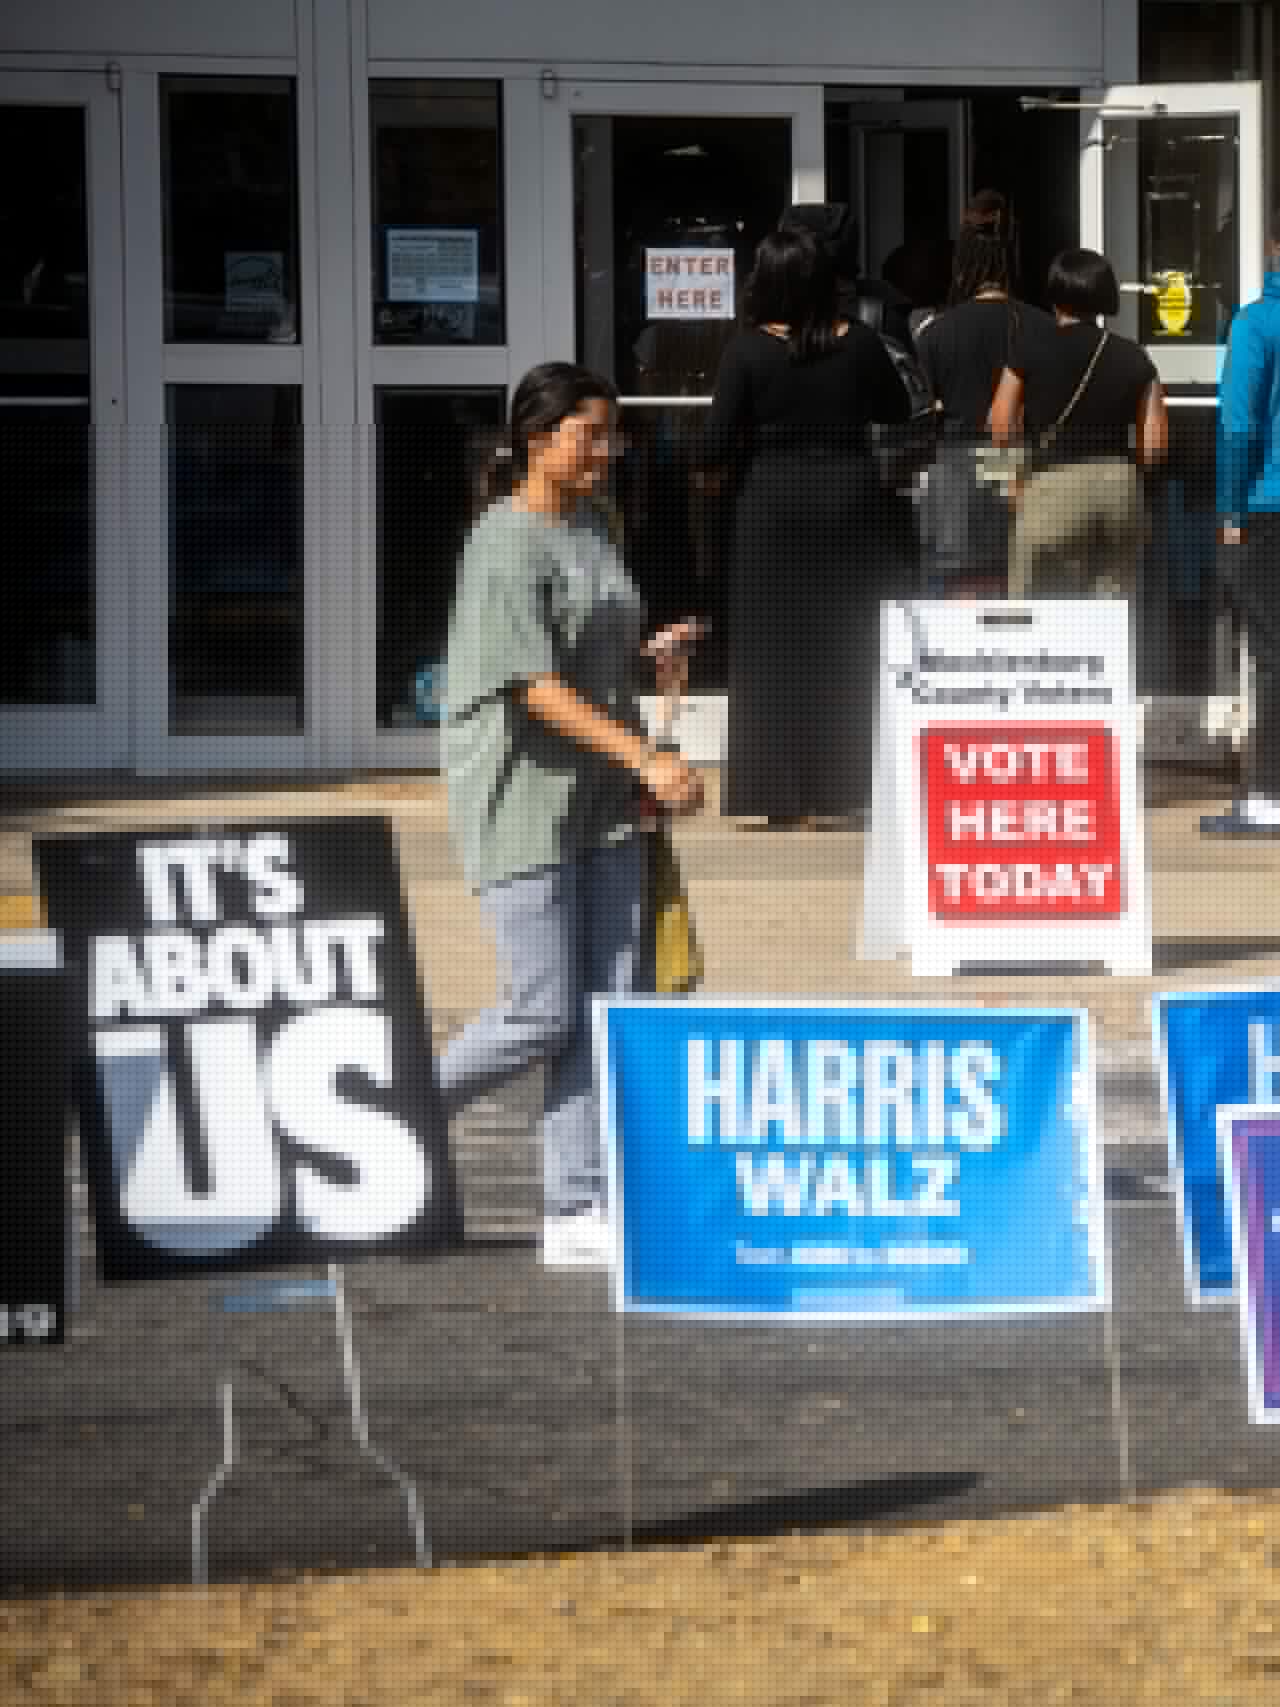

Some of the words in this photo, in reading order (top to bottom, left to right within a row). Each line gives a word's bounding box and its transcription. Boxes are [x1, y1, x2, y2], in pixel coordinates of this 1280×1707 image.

[648, 255, 729, 274] ENTER
[656, 288, 721, 309] HERE
[942, 742, 1091, 785] VOTE
[949, 800, 1098, 843] HERE
[137, 832, 306, 924] IT'S
[934, 861, 1114, 902] TODAY
[89, 917, 385, 1018] ABOUT
[686, 1039, 1004, 1151] HARRIS
[93, 1005, 429, 1257] US
[735, 1152, 961, 1217] WALZ
